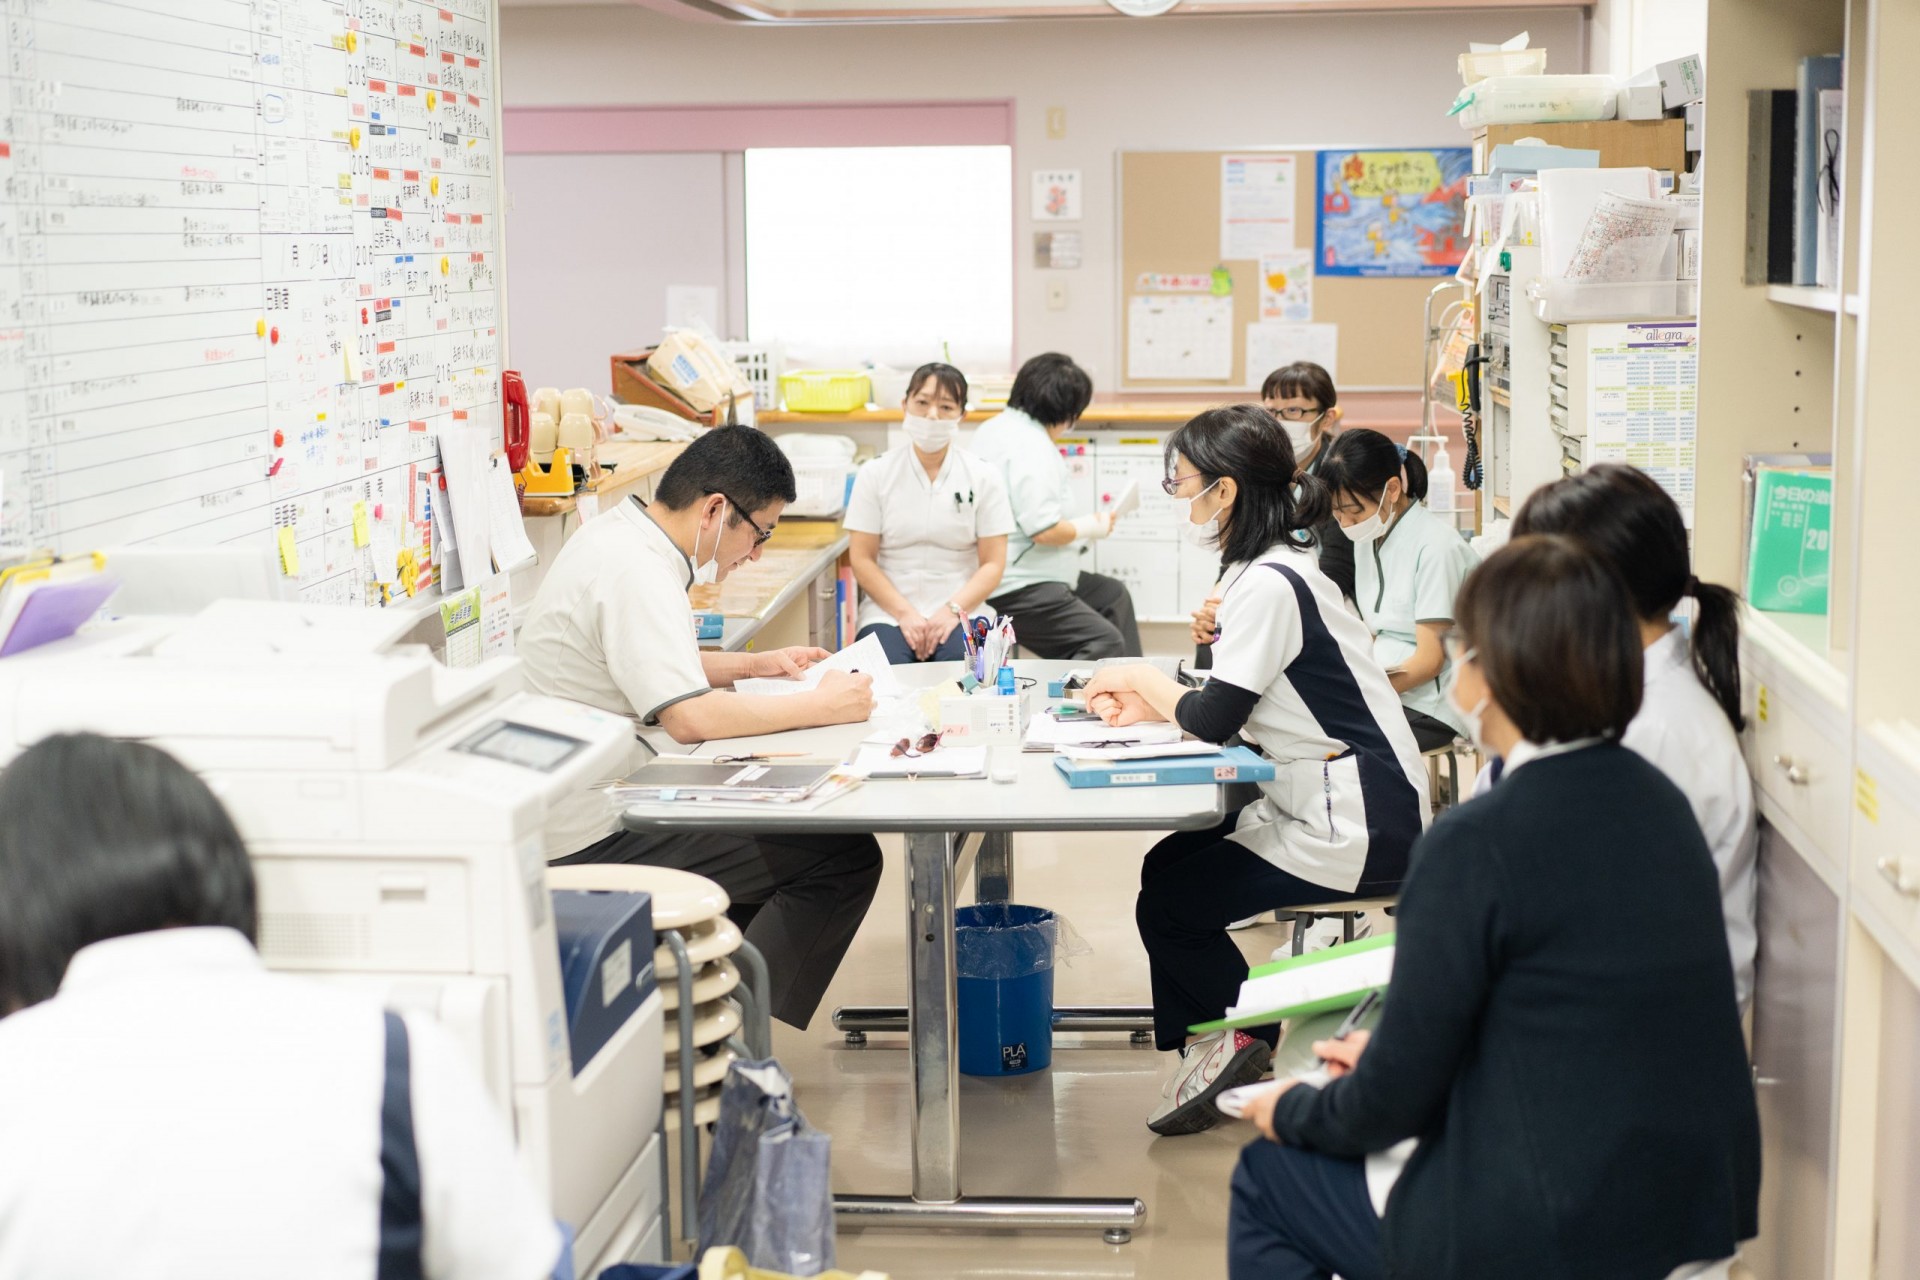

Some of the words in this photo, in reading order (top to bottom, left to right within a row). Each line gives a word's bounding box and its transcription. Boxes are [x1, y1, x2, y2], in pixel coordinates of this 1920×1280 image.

[348, 64, 366, 86] 203
[428, 121, 443, 141] 212
[431, 204, 446, 223] 213
[359, 333, 376, 355] 207
[1645, 329, 1682, 343] allegra
[436, 363, 451, 384] 216
[362, 418, 379, 443] 208
[1002, 1044, 1026, 1058] PLA
